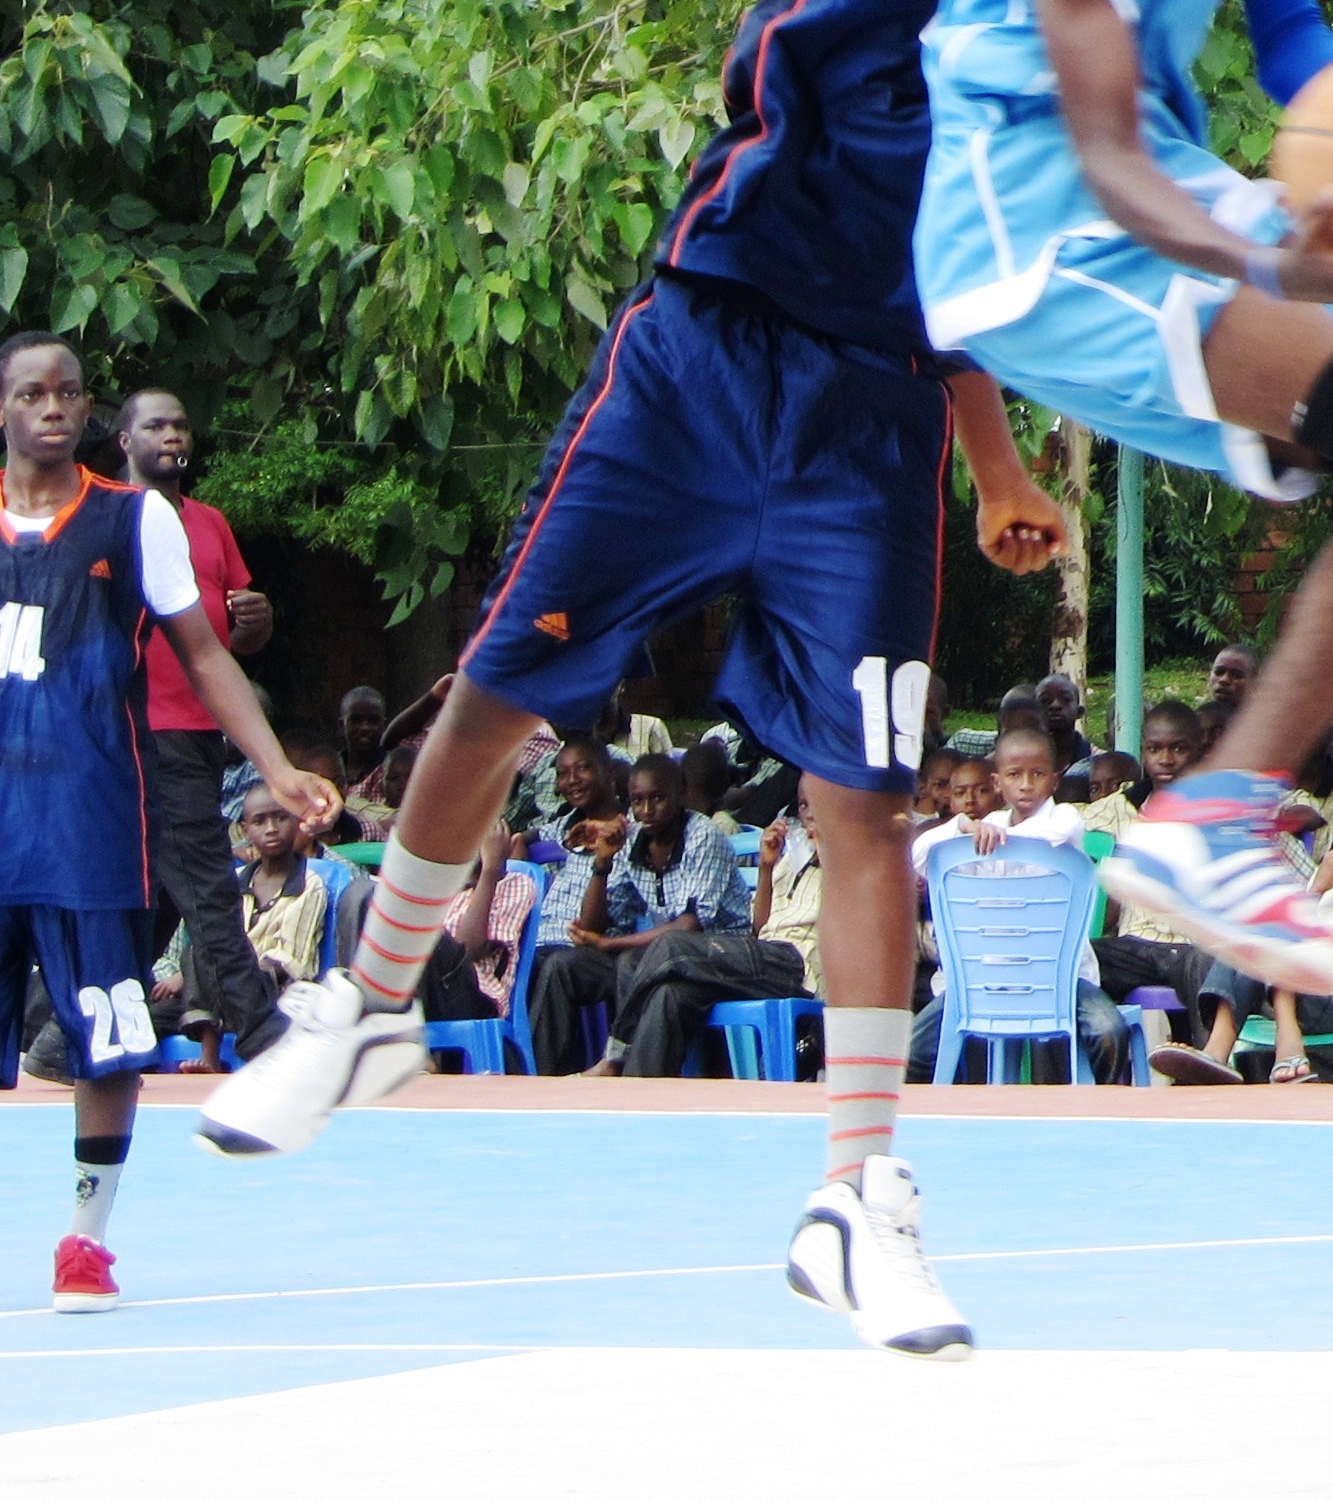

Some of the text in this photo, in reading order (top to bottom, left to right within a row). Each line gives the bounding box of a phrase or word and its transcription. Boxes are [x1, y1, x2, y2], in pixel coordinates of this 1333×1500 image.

[0, 601, 46, 681] 14
[852, 656, 931, 770] 19
[78, 977, 158, 1064] 26
